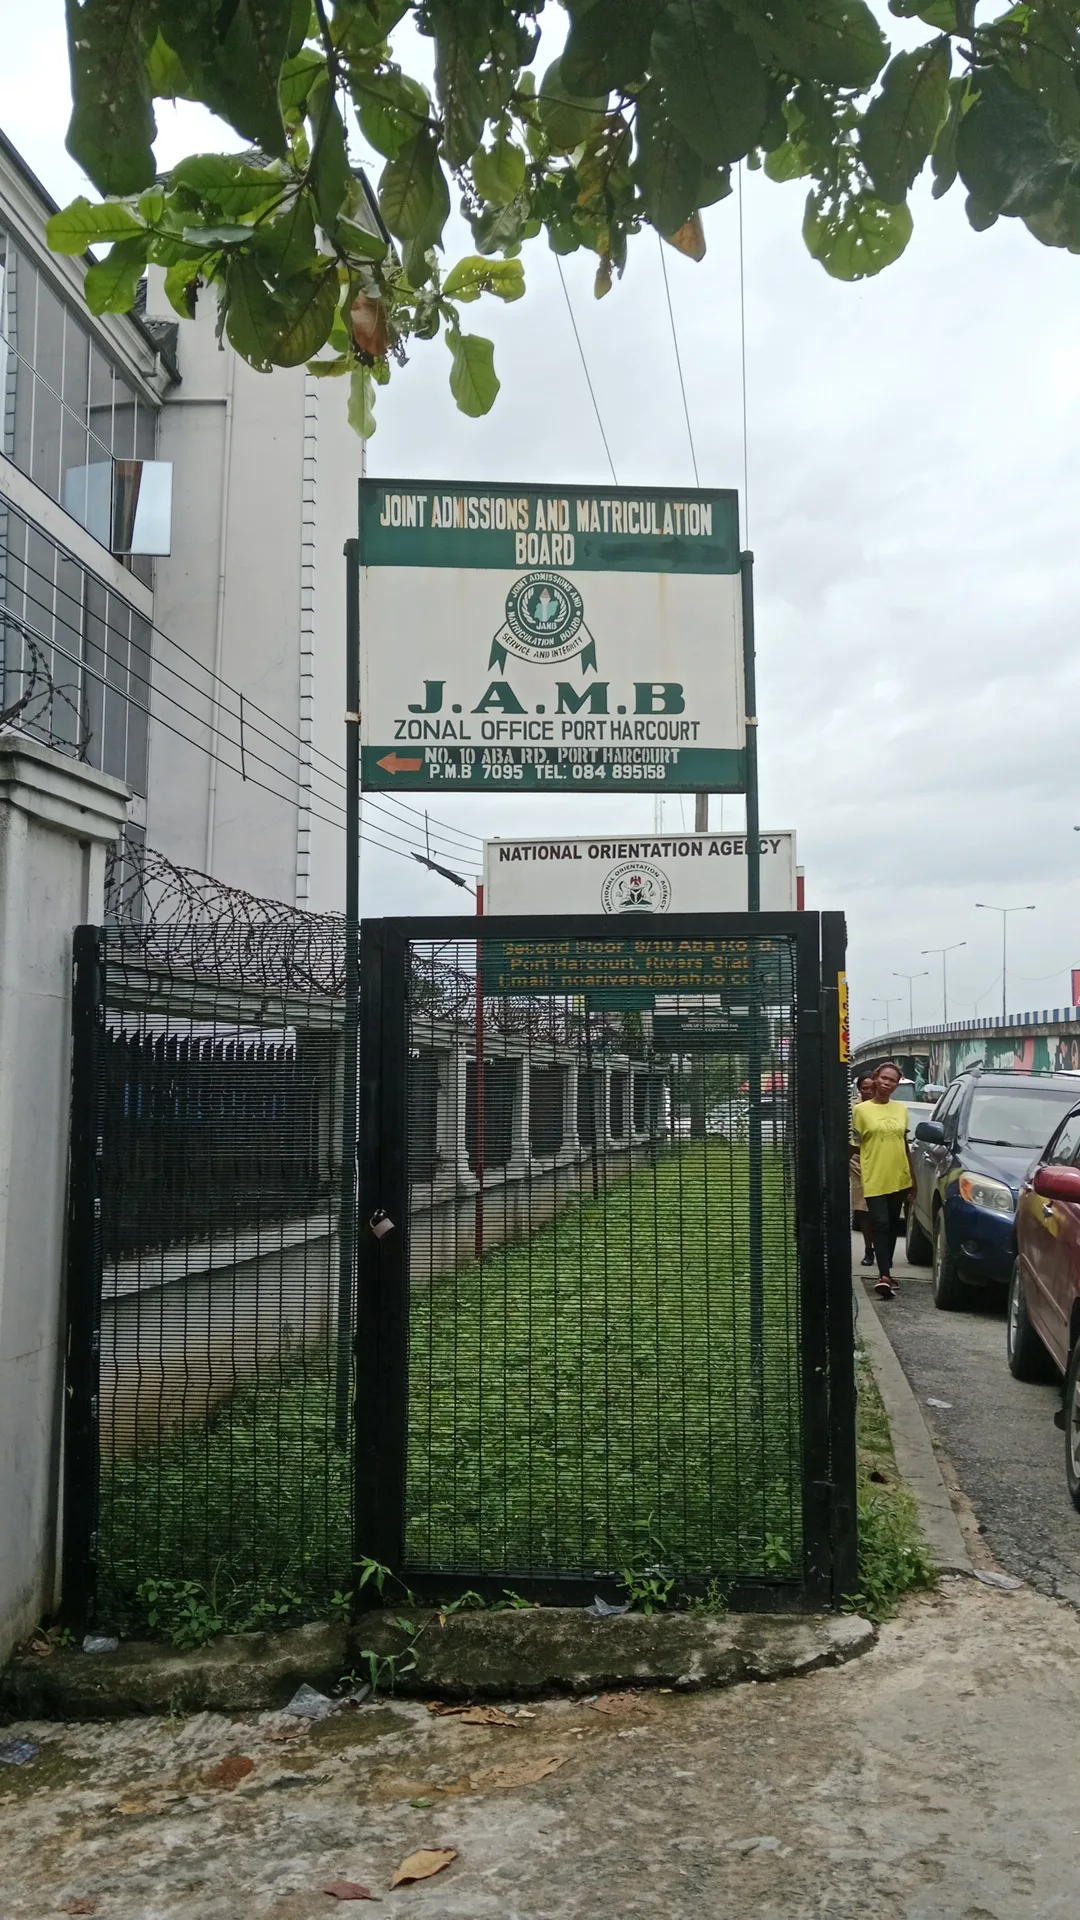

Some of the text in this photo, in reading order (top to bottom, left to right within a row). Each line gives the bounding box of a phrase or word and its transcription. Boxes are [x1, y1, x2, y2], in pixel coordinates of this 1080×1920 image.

[380, 494, 713, 537] JOINT ADMISSIONS AND MATRICULATION
[515, 532, 575, 567] BOARD
[511, 572, 582, 608] JOINT ADMISSIONS AND
[507, 611, 581, 647] MATRICULATION BOARD
[536, 621, 557, 630] JAMB
[502, 632, 531, 656] SERVICE
[533, 650, 550, 659] AND
[408, 679, 685, 715] J.A.M.B
[394, 719, 701, 741] ZONAL OFFICE PORT HARCOURT
[459, 747, 476, 764] 10
[481, 748, 515, 765] ABA
[557, 747, 599, 764] PORT
[602, 748, 681, 764] HARCOURT
[429, 764, 472, 779] P.M.B
[482, 764, 524, 779] 7095
[572, 764, 607, 780] 084
[612, 764, 667, 780] 895158
[499, 839, 782, 862] NATIONAL ORIENTATION AGECY
[604, 864, 668, 913] NATIONAL ORIENTATION AGENCY
[502, 941, 570, 955] Second
[511, 957, 549, 971] Port
[645, 956, 704, 970] Rivers
